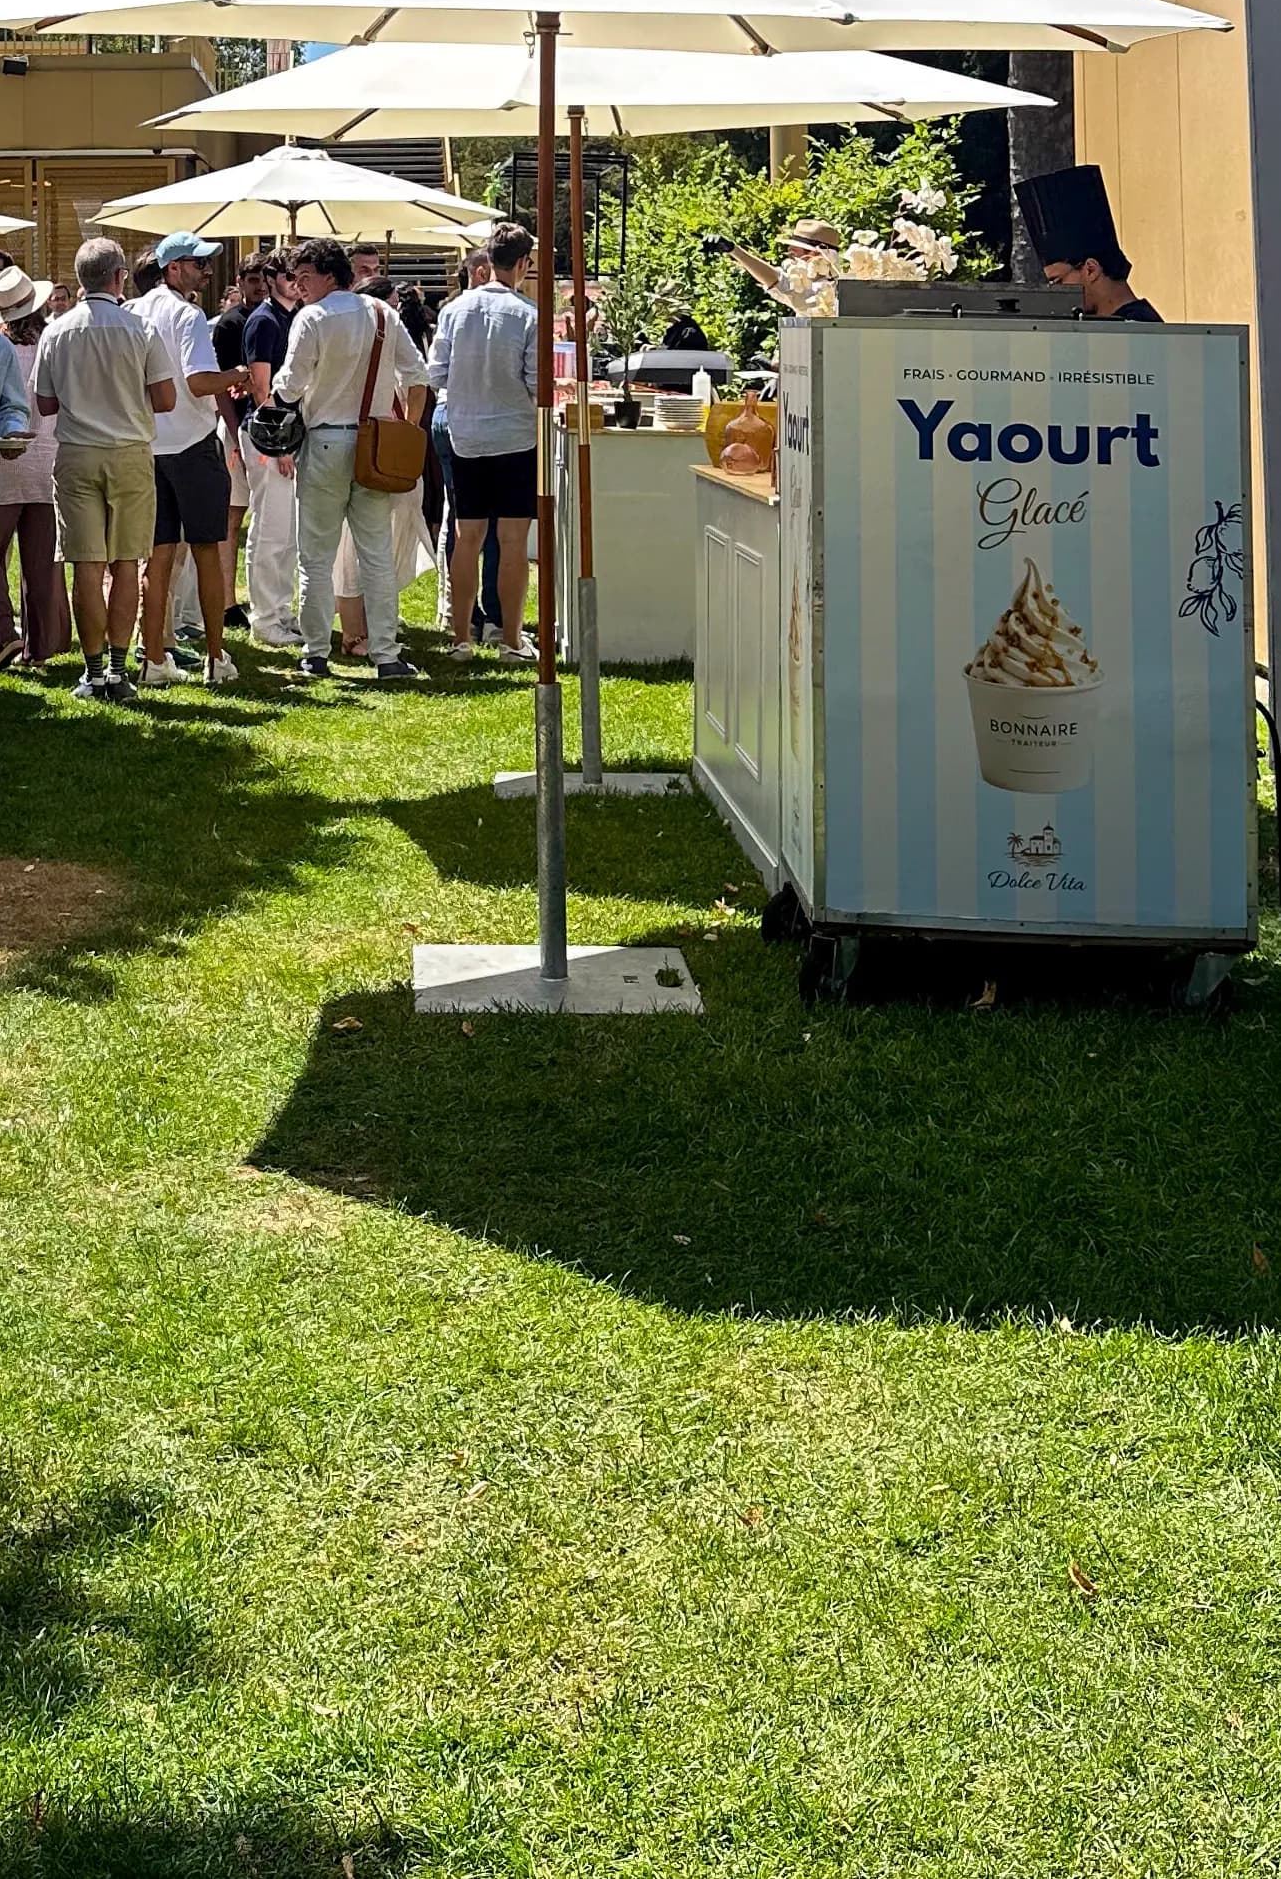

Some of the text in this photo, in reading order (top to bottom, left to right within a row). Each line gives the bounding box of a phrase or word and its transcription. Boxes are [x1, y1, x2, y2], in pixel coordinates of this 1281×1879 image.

[903, 368, 1156, 386] FRAIS GOURMAND IRRÉSISTIBLE
[896, 399, 1161, 468] Yaourt
[976, 477, 1090, 550] Glacé
[990, 719, 1079, 737] BONNAIRE
[1011, 738, 1057, 748] TRAITEUR
[987, 870, 1088, 891] Dolce Vita
